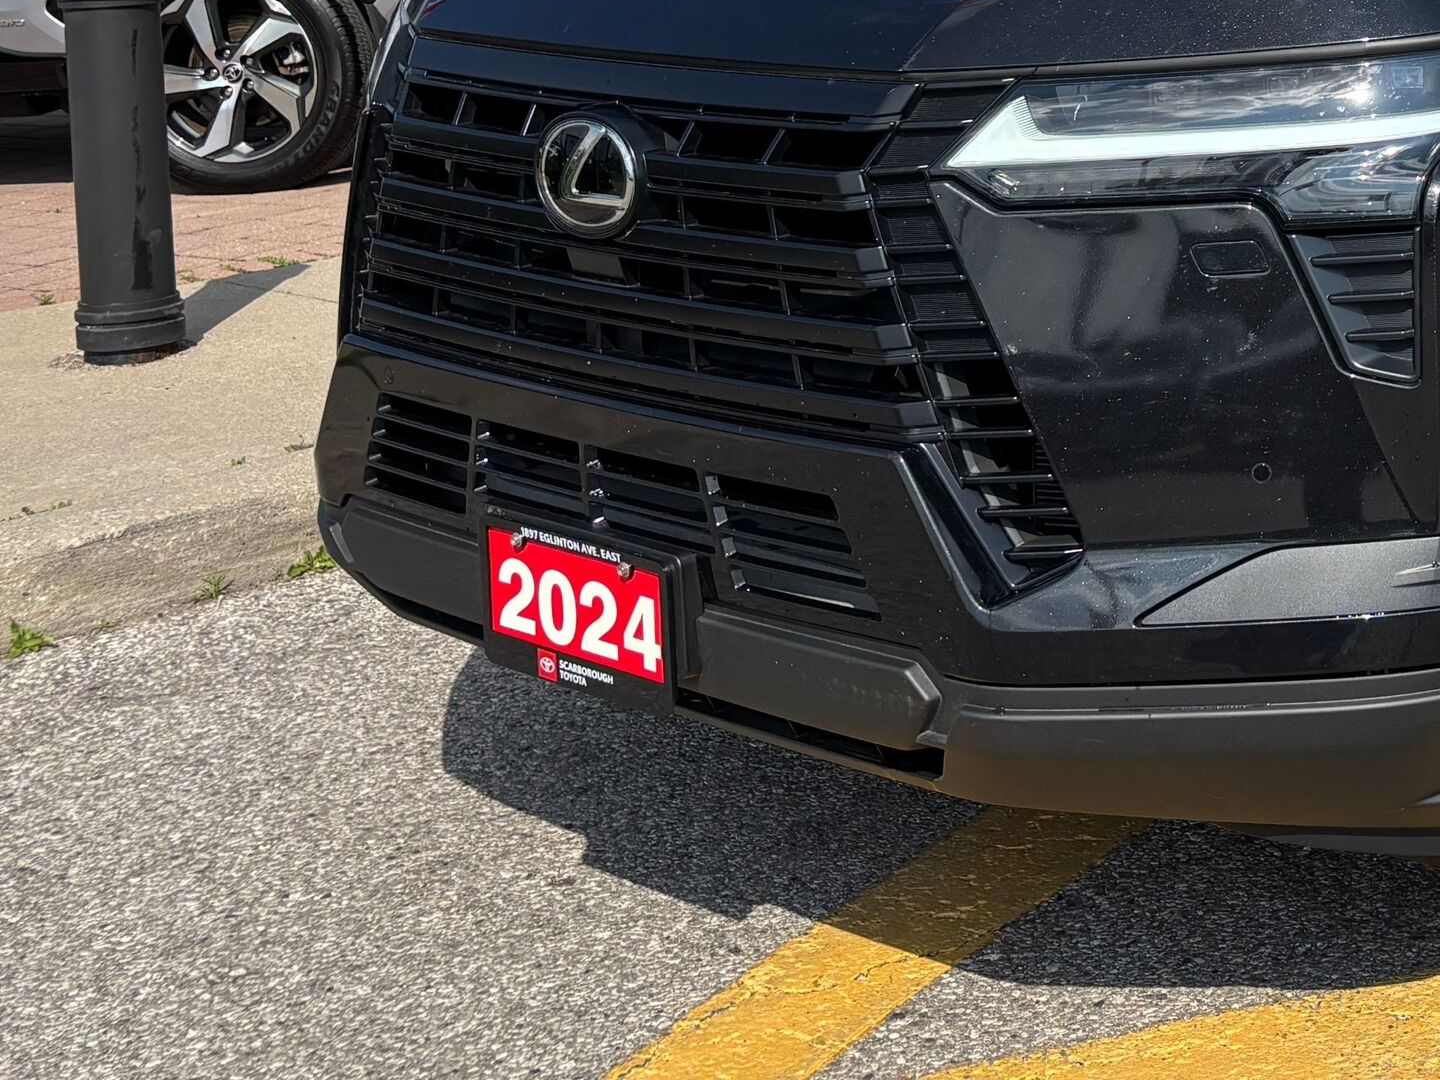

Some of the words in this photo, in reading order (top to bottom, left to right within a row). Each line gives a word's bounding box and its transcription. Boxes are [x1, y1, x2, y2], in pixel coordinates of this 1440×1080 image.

[520, 526, 538, 540] 1897
[538, 531, 580, 552] EGLINTON
[580, 542, 600, 558] AVE.
[600, 548, 621, 563] EAST
[498, 557, 662, 674] 2024
[558, 659, 614, 685] SCARBOROUGH
[559, 669, 588, 687] TOYOTA
